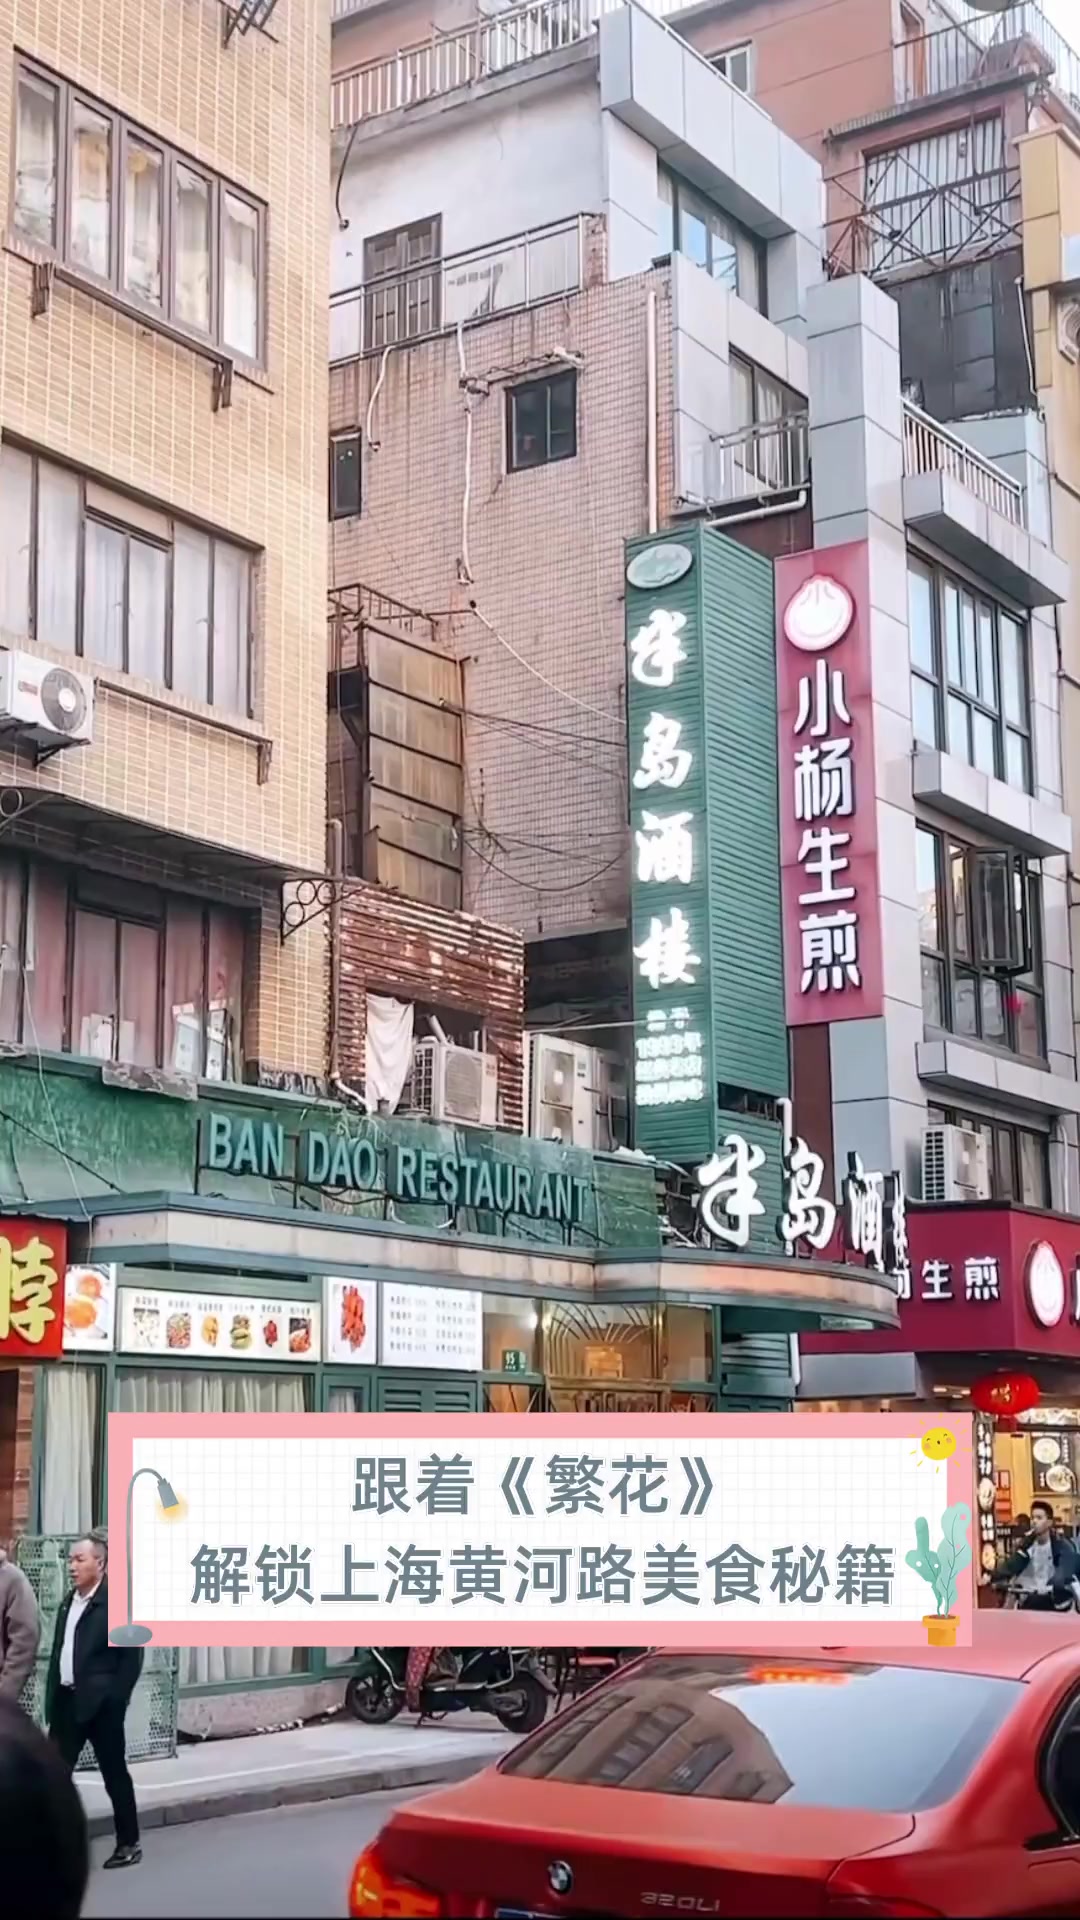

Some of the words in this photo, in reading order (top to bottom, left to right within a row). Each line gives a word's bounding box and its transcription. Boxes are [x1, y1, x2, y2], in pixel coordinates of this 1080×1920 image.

[630, 609, 701, 990] 半岛酒楼
[794, 659, 859, 992] 小杨生煎
[209, 1112, 284, 1177] BAN
[308, 1130, 376, 1189] DAO
[397, 1145, 588, 1222] RESTAURANT
